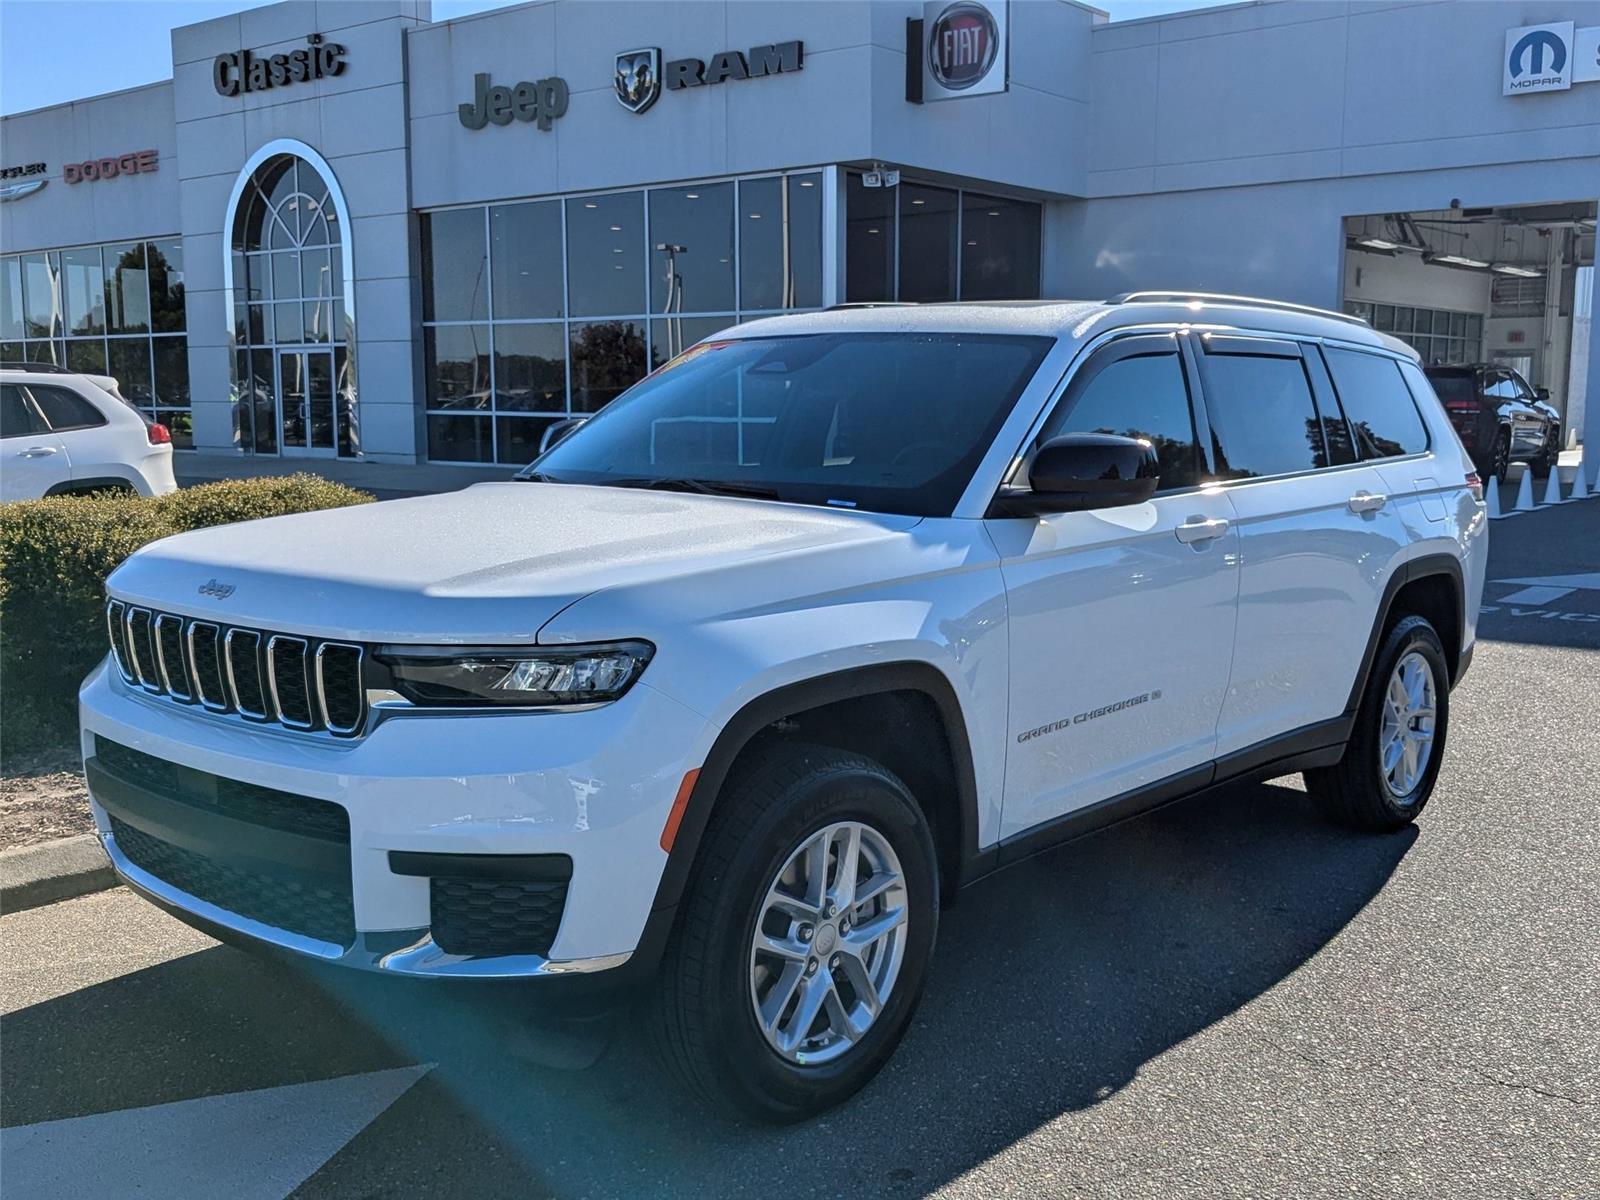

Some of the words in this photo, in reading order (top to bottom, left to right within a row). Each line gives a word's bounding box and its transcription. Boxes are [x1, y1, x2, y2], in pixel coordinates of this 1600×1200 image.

[213, 33, 347, 97] Classic
[665, 40, 804, 91] RAM
[943, 26, 983, 68] FIAT
[458, 72, 570, 132] Jeep
[1510, 77, 1562, 90] MOPAR
[63, 149, 160, 185] DODGE
[1016, 717, 1070, 744] GRAND
[1073, 693, 1150, 725] CHEROKEE
